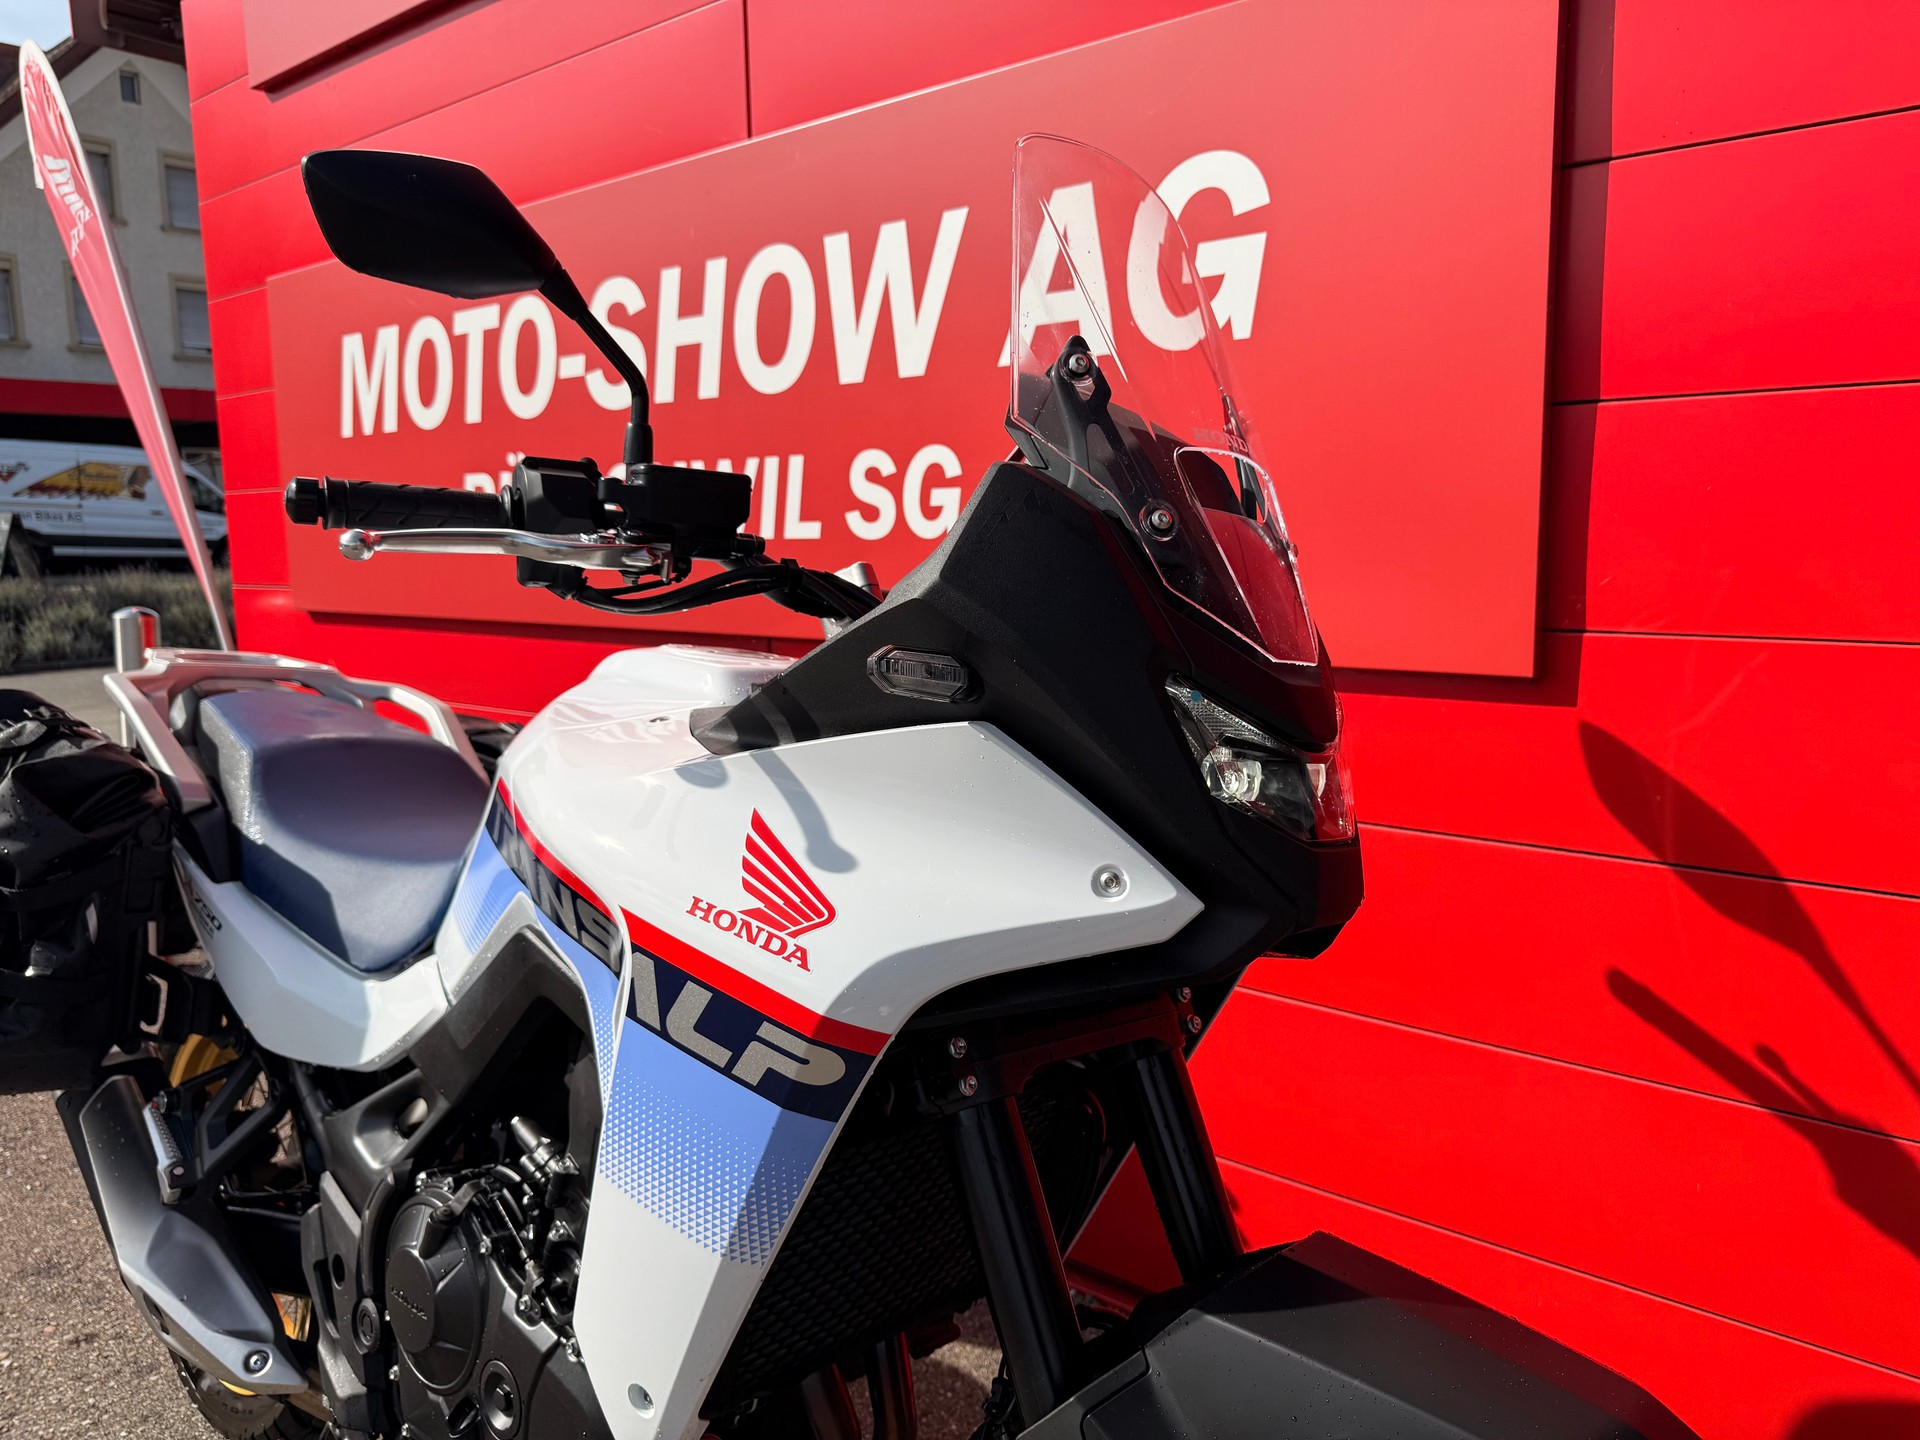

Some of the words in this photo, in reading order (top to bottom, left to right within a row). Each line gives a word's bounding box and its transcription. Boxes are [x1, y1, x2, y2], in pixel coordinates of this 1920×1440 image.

[340, 206, 969, 439] MOTO-SHOW
[998, 149, 1272, 367] AG
[845, 443, 963, 540] SG
[687, 897, 812, 972] HONDA
